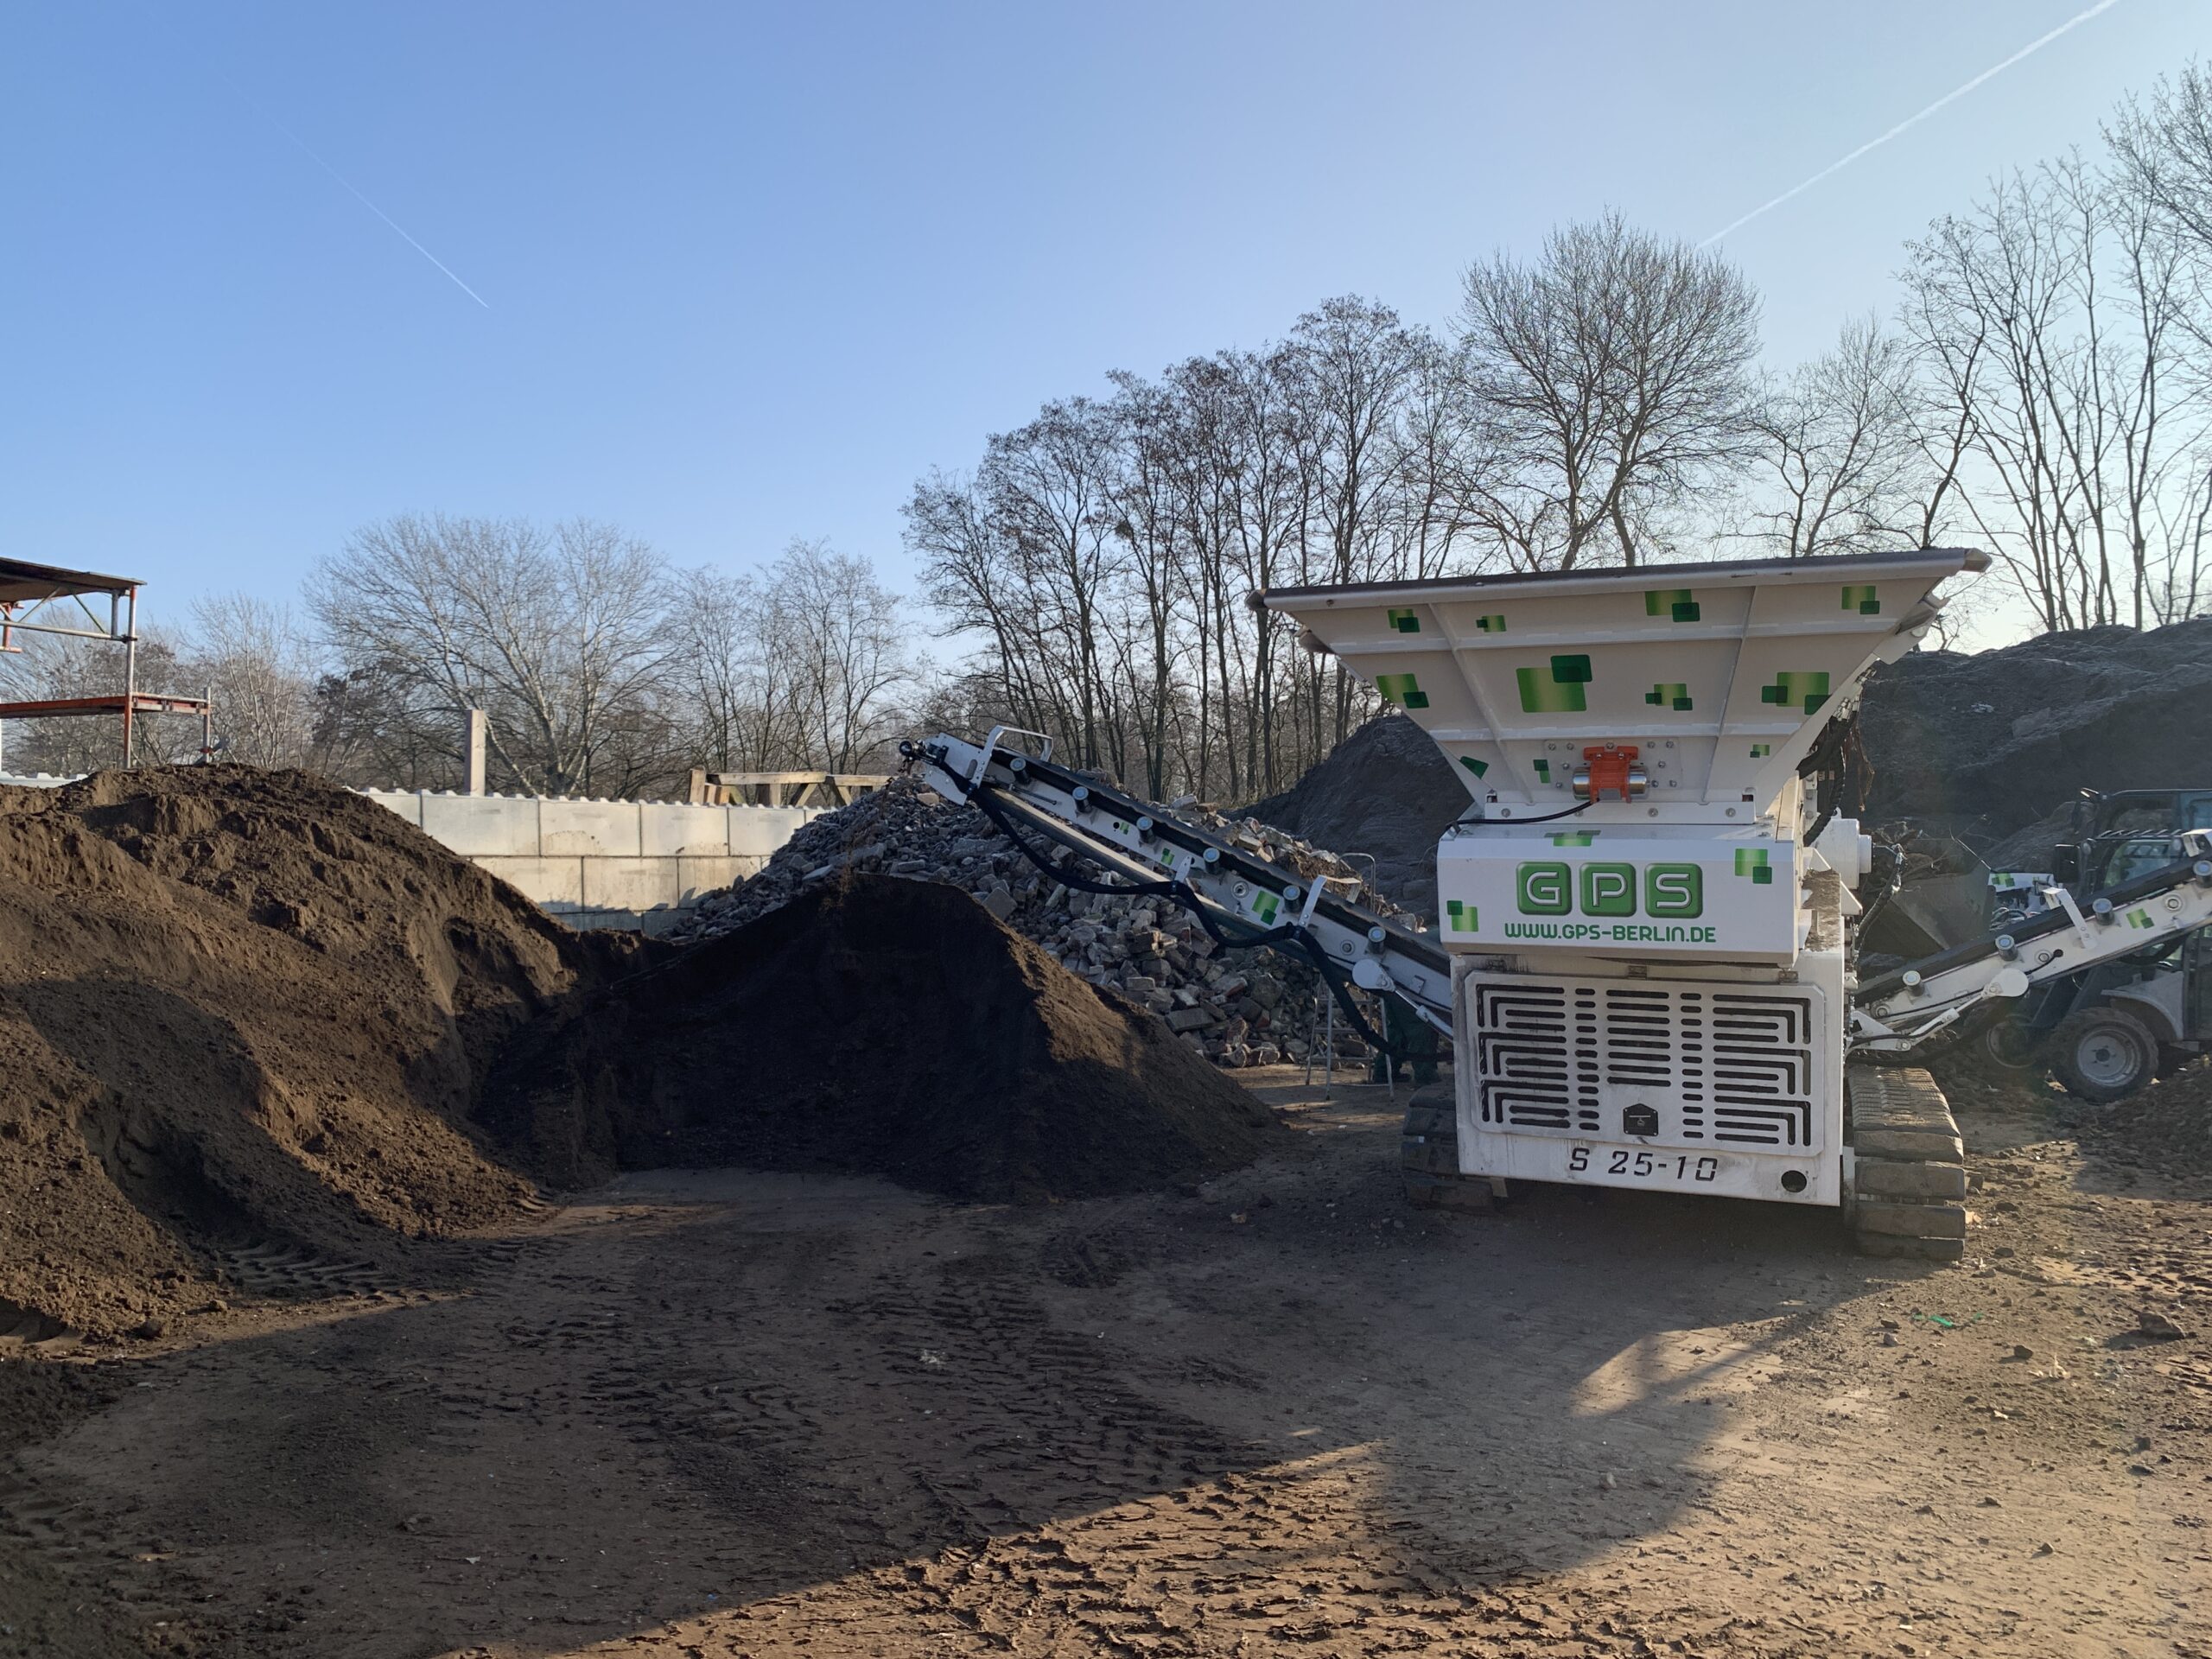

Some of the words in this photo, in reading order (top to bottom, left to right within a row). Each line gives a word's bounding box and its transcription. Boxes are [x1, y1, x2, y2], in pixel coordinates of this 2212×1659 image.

[1524, 869, 1694, 911] GPS
[1504, 923, 1716, 943] WWW.GPS-BERLIN.DE
[1569, 1147, 1590, 1171] S
[1608, 1150, 1718, 1181] 25-10
